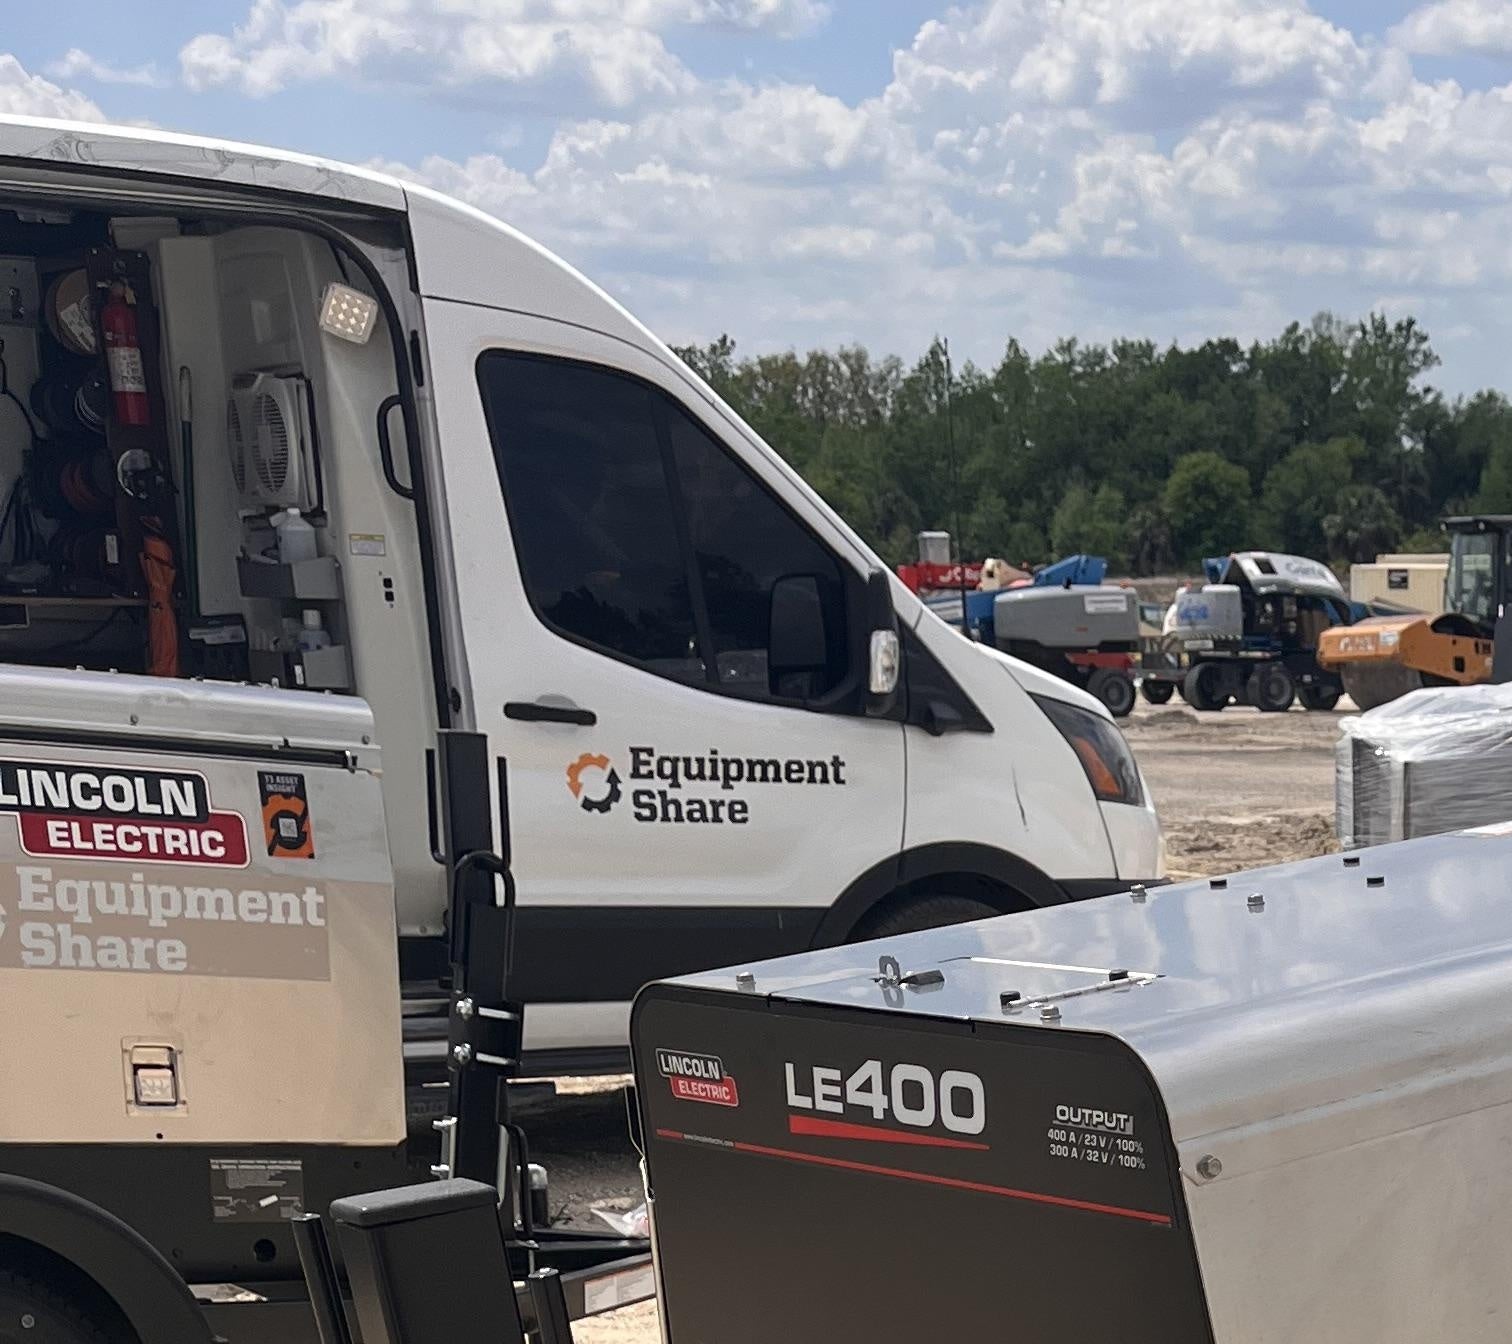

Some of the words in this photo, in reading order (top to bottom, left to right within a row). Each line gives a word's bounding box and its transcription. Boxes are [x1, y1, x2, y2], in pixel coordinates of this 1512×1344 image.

[630, 747, 845, 790] Equipment
[633, 790, 749, 824] Share
[47, 819, 226, 858] ELECTRIC
[16, 866, 326, 928] Equipment
[19, 922, 188, 971] Share
[660, 1053, 720, 1080] LINCOLN
[678, 1080, 731, 1100] ELECTRIC
[785, 1059, 985, 1135] LE400
[1056, 1105, 1128, 1130] OUTPUT
[1048, 1128, 1066, 1142] 400
[1068, 1132, 1076, 1143] A
[1084, 1134, 1097, 1147] 23
[1099, 1136, 1107, 1148] V
[1116, 1139, 1144, 1154] 100%
[1050, 1144, 1069, 1157] 300
[1071, 1147, 1078, 1159] A
[1086, 1150, 1099, 1162] 32
[1101, 1152, 1109, 1163] V
[1118, 1155, 1146, 1170] 100%
